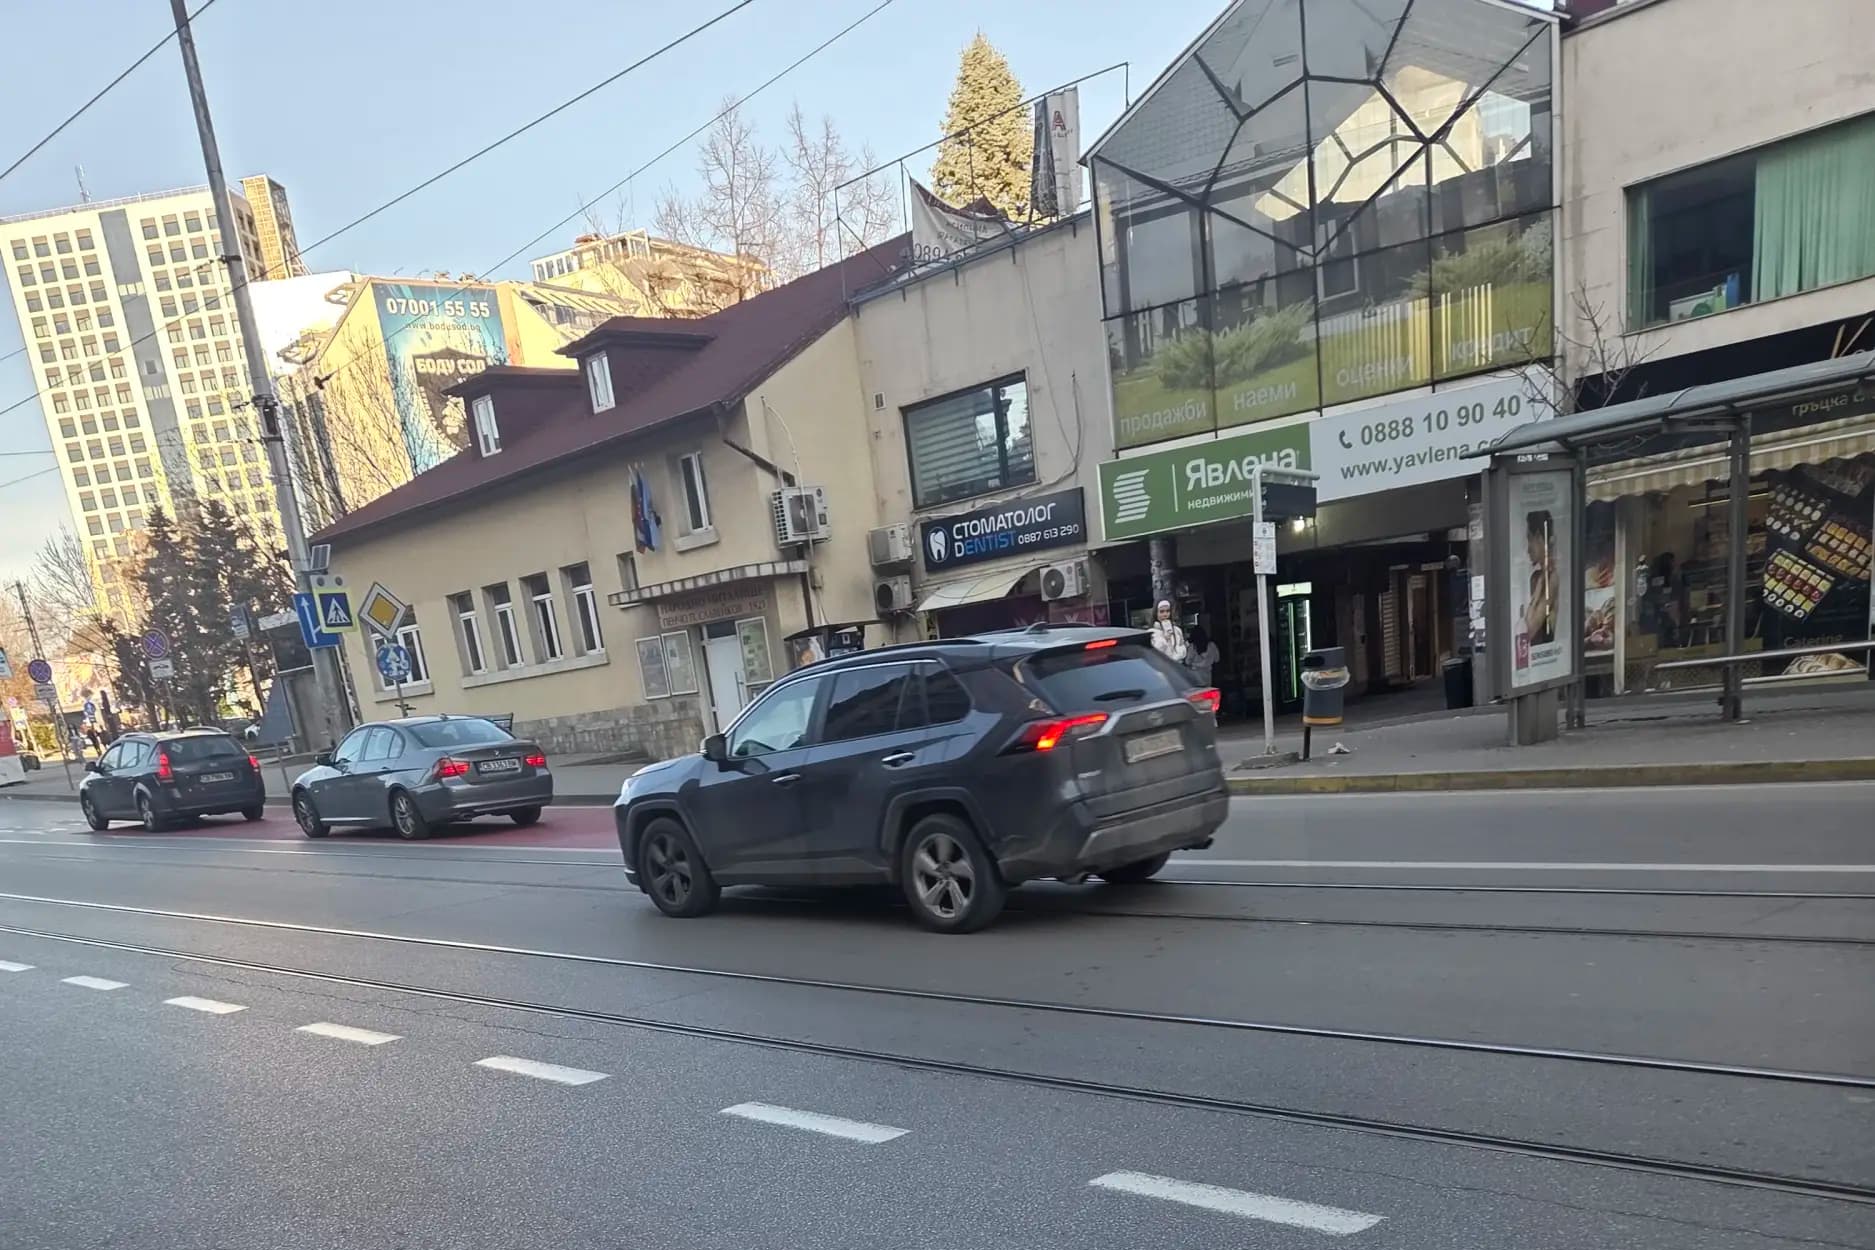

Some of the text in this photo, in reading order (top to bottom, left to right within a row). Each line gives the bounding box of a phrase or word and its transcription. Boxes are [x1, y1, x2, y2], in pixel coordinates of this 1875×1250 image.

[386, 297, 490, 318] 07001 55 55
[1452, 326, 1533, 363] крдит
[415, 358, 455, 375] БОДУ
[1233, 381, 1297, 411] наеми
[1120, 397, 1208, 436] продажби
[1360, 394, 1521, 446] 0888 10 90 40
[1185, 448, 1297, 492] Явлена
[1340, 438, 1500, 480] www.yavlenaco
[952, 502, 1056, 540] СТОМАТОЛОГ
[954, 523, 1080, 558] DENTIST 0887 613 290
